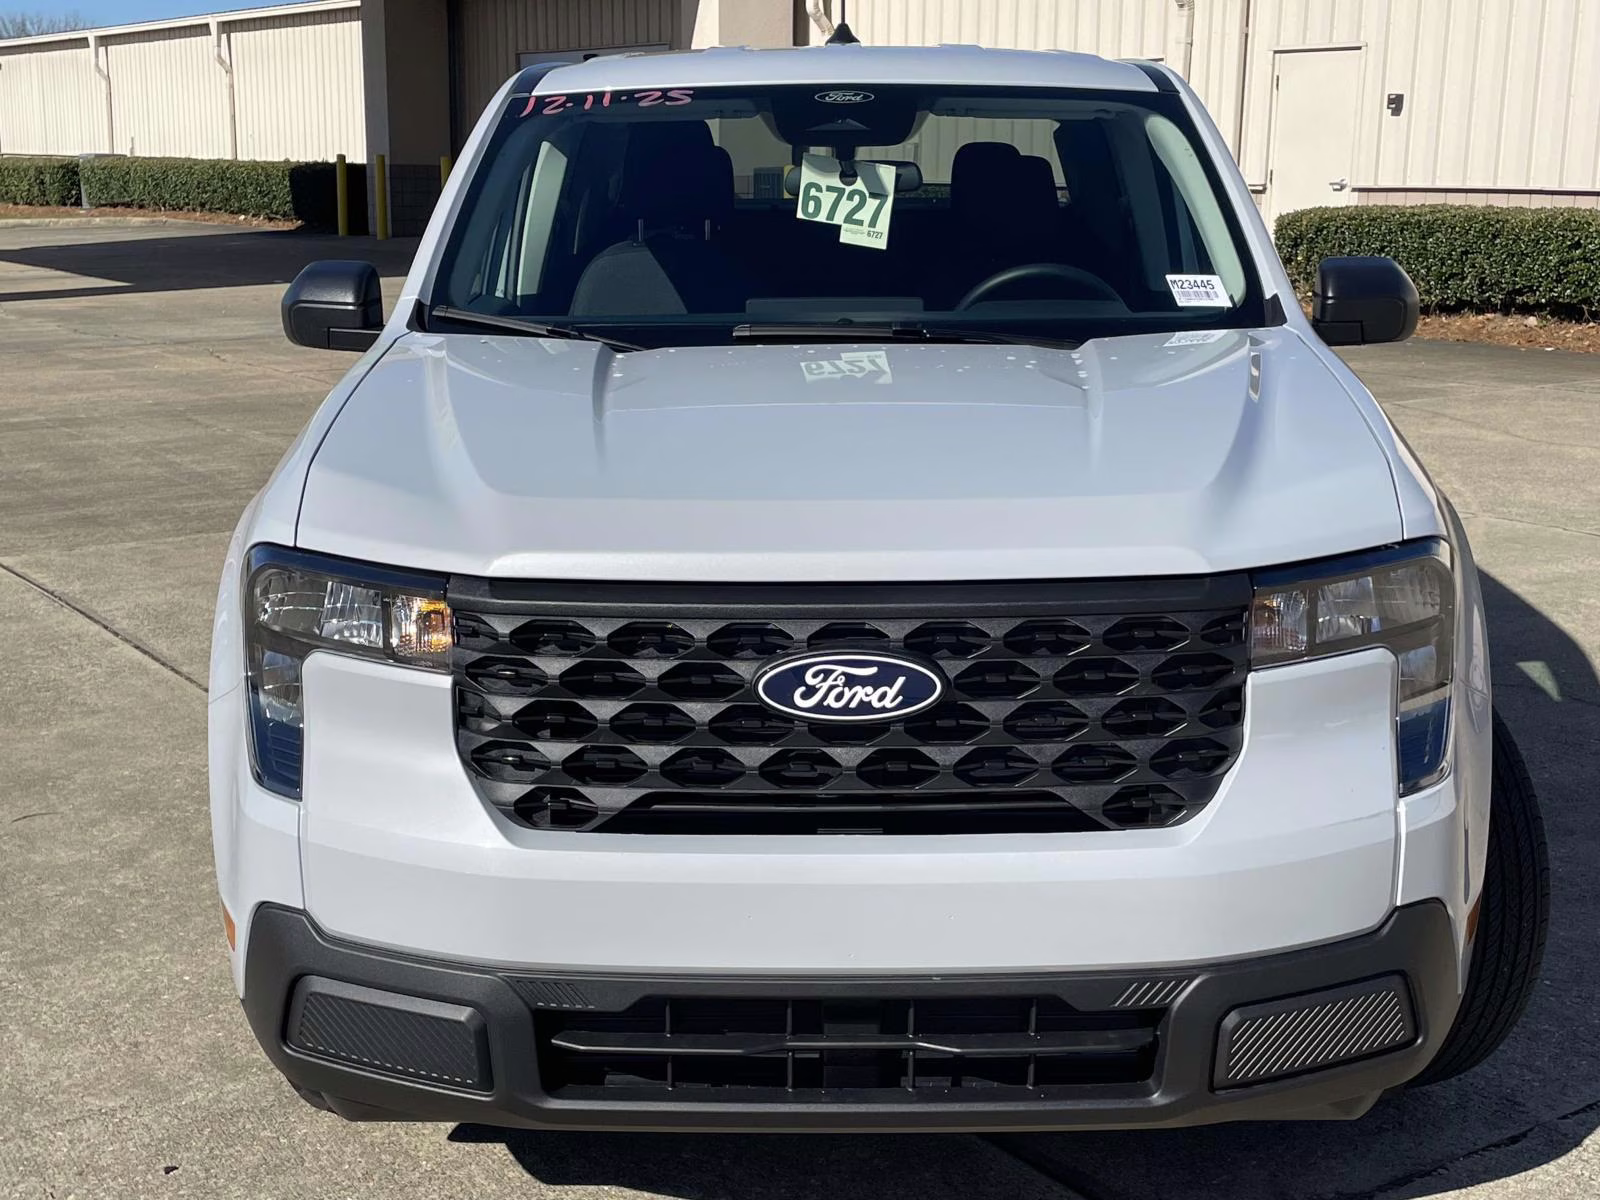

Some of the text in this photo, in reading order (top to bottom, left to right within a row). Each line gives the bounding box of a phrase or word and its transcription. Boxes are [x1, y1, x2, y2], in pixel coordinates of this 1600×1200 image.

[825, 92, 864, 101] Ford
[800, 181, 889, 230] 6727
[866, 230, 883, 240] 6727
[1169, 279, 1215, 290] M23445
[793, 664, 906, 709] Ford
